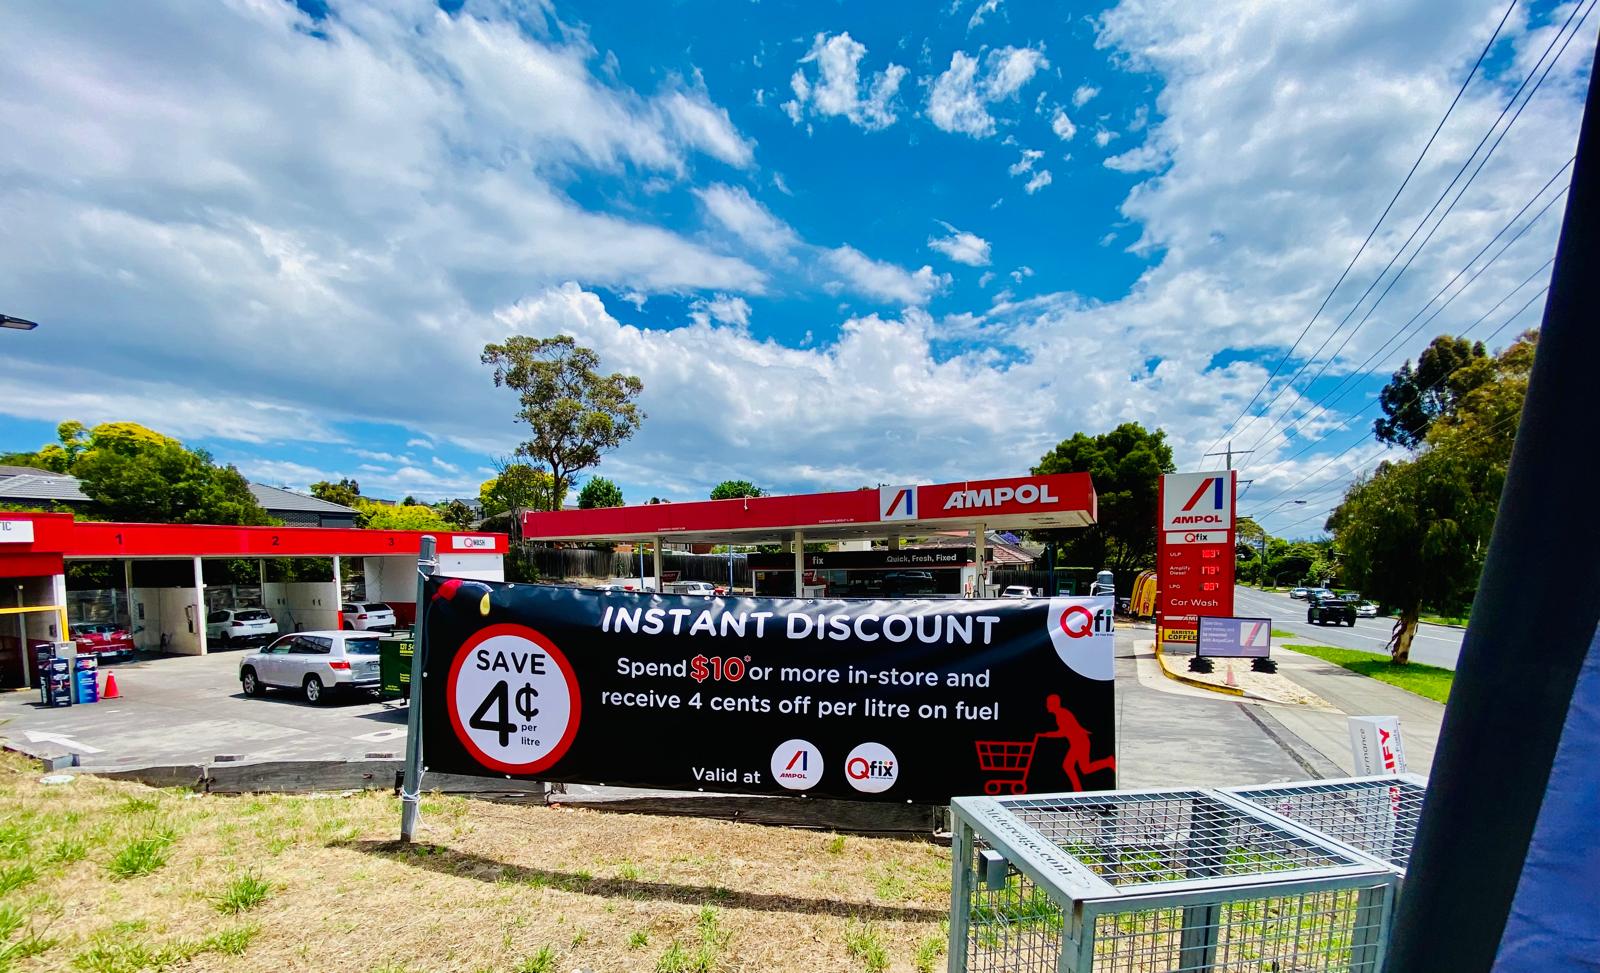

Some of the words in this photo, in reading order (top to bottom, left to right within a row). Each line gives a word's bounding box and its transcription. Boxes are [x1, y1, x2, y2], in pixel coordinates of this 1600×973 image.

[943, 484, 1059, 511] AMPOL
[1172, 515, 1223, 525] AMPOL
[115, 533, 123, 545] 1
[271, 535, 280, 547] 2
[1185, 533, 1208, 543] Qfix
[886, 555, 911, 563] Quick,
[912, 554, 934, 562] Fresh,
[936, 553, 957, 561] Fixed
[1191, 599, 1219, 607] Wash
[602, 605, 773, 639] INSTANT
[786, 612, 1000, 644] DISCOUNT
[476, 649, 546, 675] SAVE
[617, 657, 687, 678] Spend
[749, 665, 773, 680] or
[780, 667, 840, 683] more
[848, 666, 939, 687] in-store
[946, 668, 990, 688] and
[601, 690, 680, 710] receive
[688, 692, 703, 710] 4
[710, 695, 771, 713] cents
[778, 696, 811, 714] off
[818, 700, 857, 719] per
[864, 698, 911, 718] litre
[917, 704, 948, 720] on
[955, 700, 1000, 721] fuel
[521, 723, 538, 734] per
[521, 736, 541, 748] litre
[847, 757, 894, 780] Qfix
[692, 767, 739, 783] Valid
[743, 769, 761, 784] at
